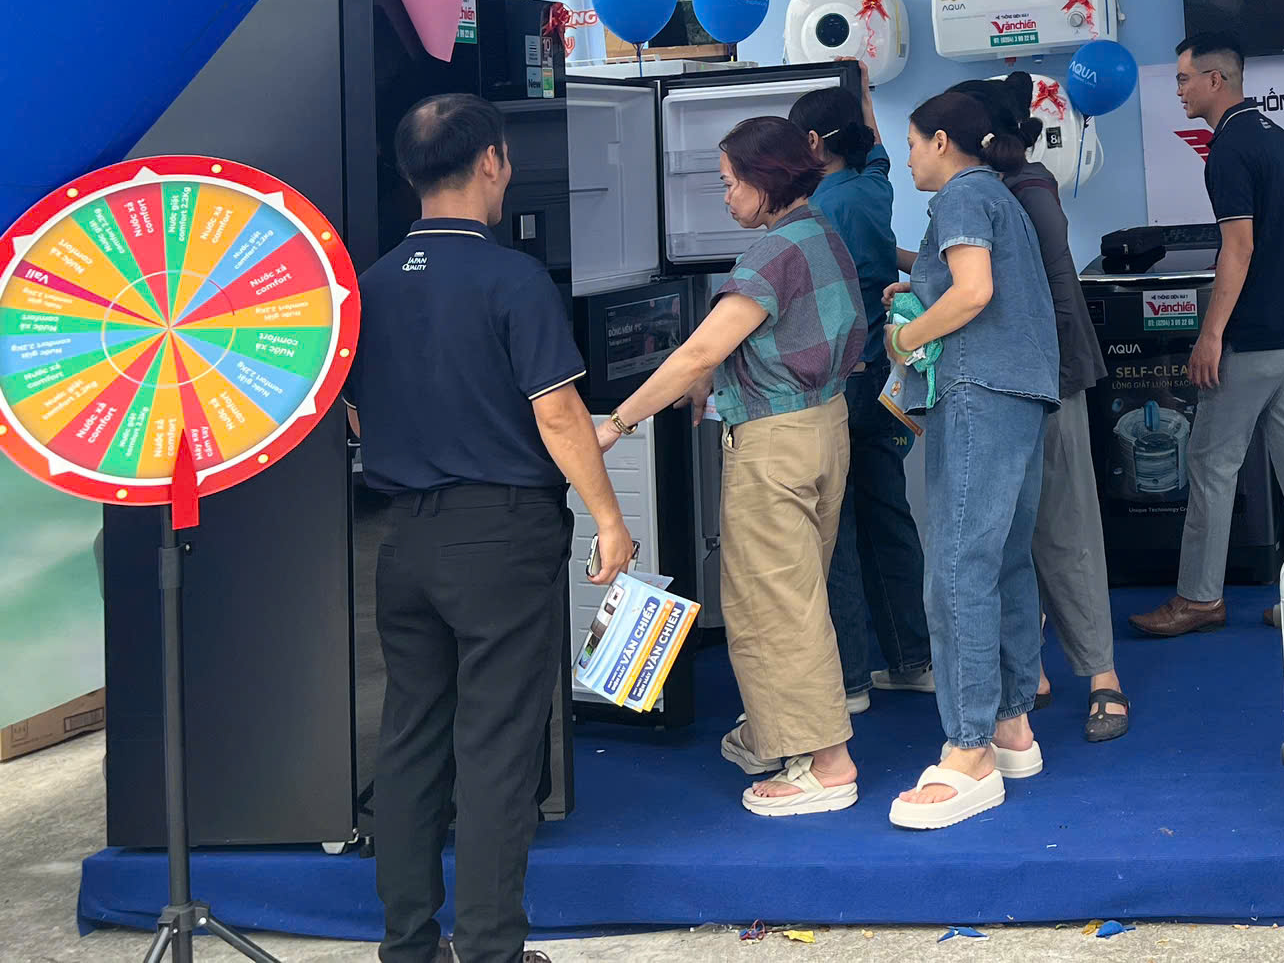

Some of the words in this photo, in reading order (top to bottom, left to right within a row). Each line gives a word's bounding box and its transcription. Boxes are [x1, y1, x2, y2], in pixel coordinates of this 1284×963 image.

[942, 3, 966, 12] AQUA
[1069, 61, 1097, 83] AQUA
[408, 256, 427, 264] JAPAN
[25, 269, 49, 284] Vali
[1108, 344, 1141, 354] AQUA
[1116, 365, 1189, 378] SELF-CLEA
